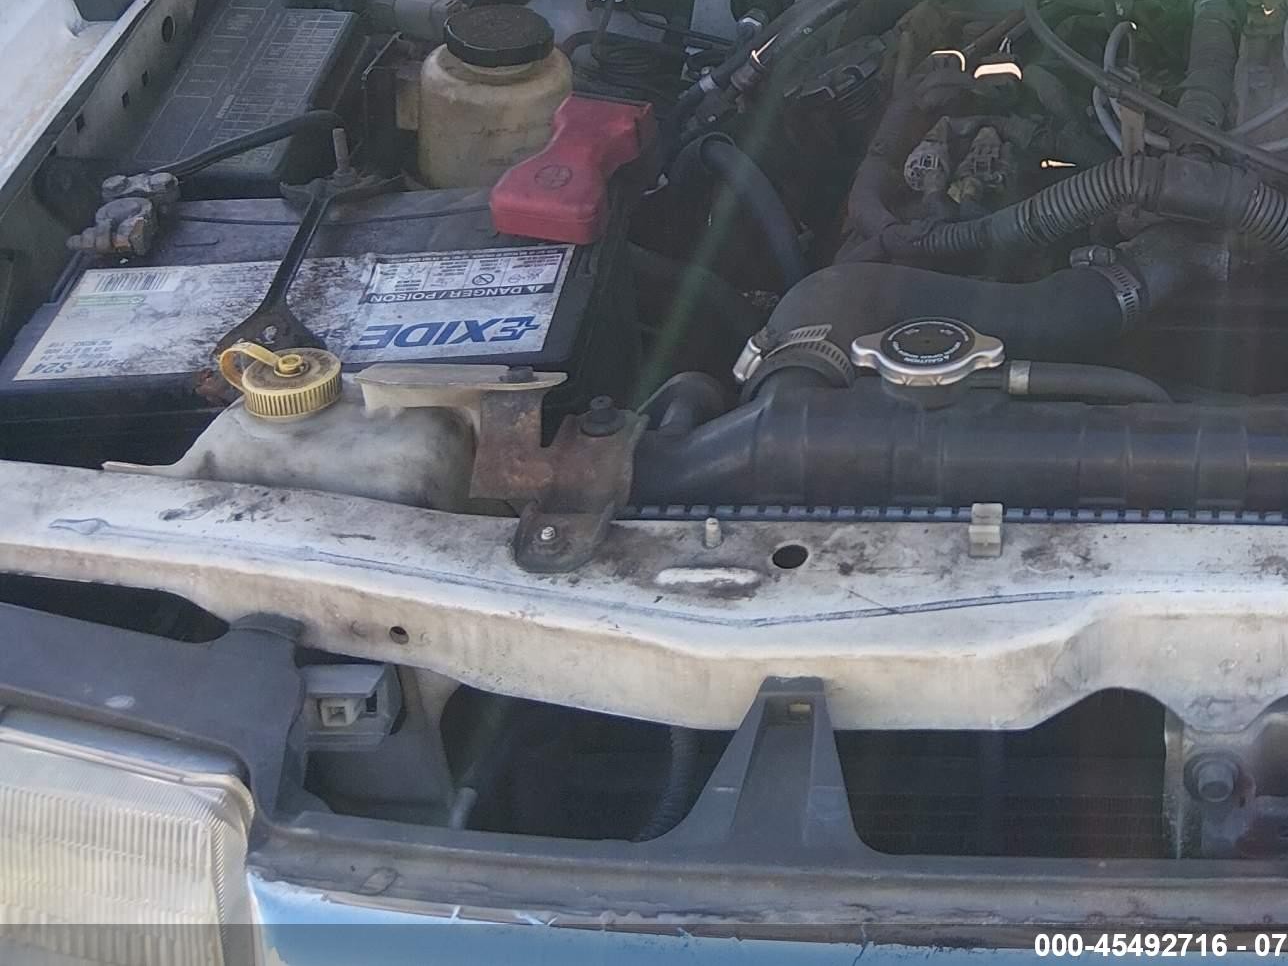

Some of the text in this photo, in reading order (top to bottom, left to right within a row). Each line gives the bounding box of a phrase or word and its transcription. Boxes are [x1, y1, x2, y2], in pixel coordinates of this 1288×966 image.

[370, 292, 436, 303] POISON
[451, 287, 523, 299] DANGER
[350, 314, 540, 351] EXIDE
